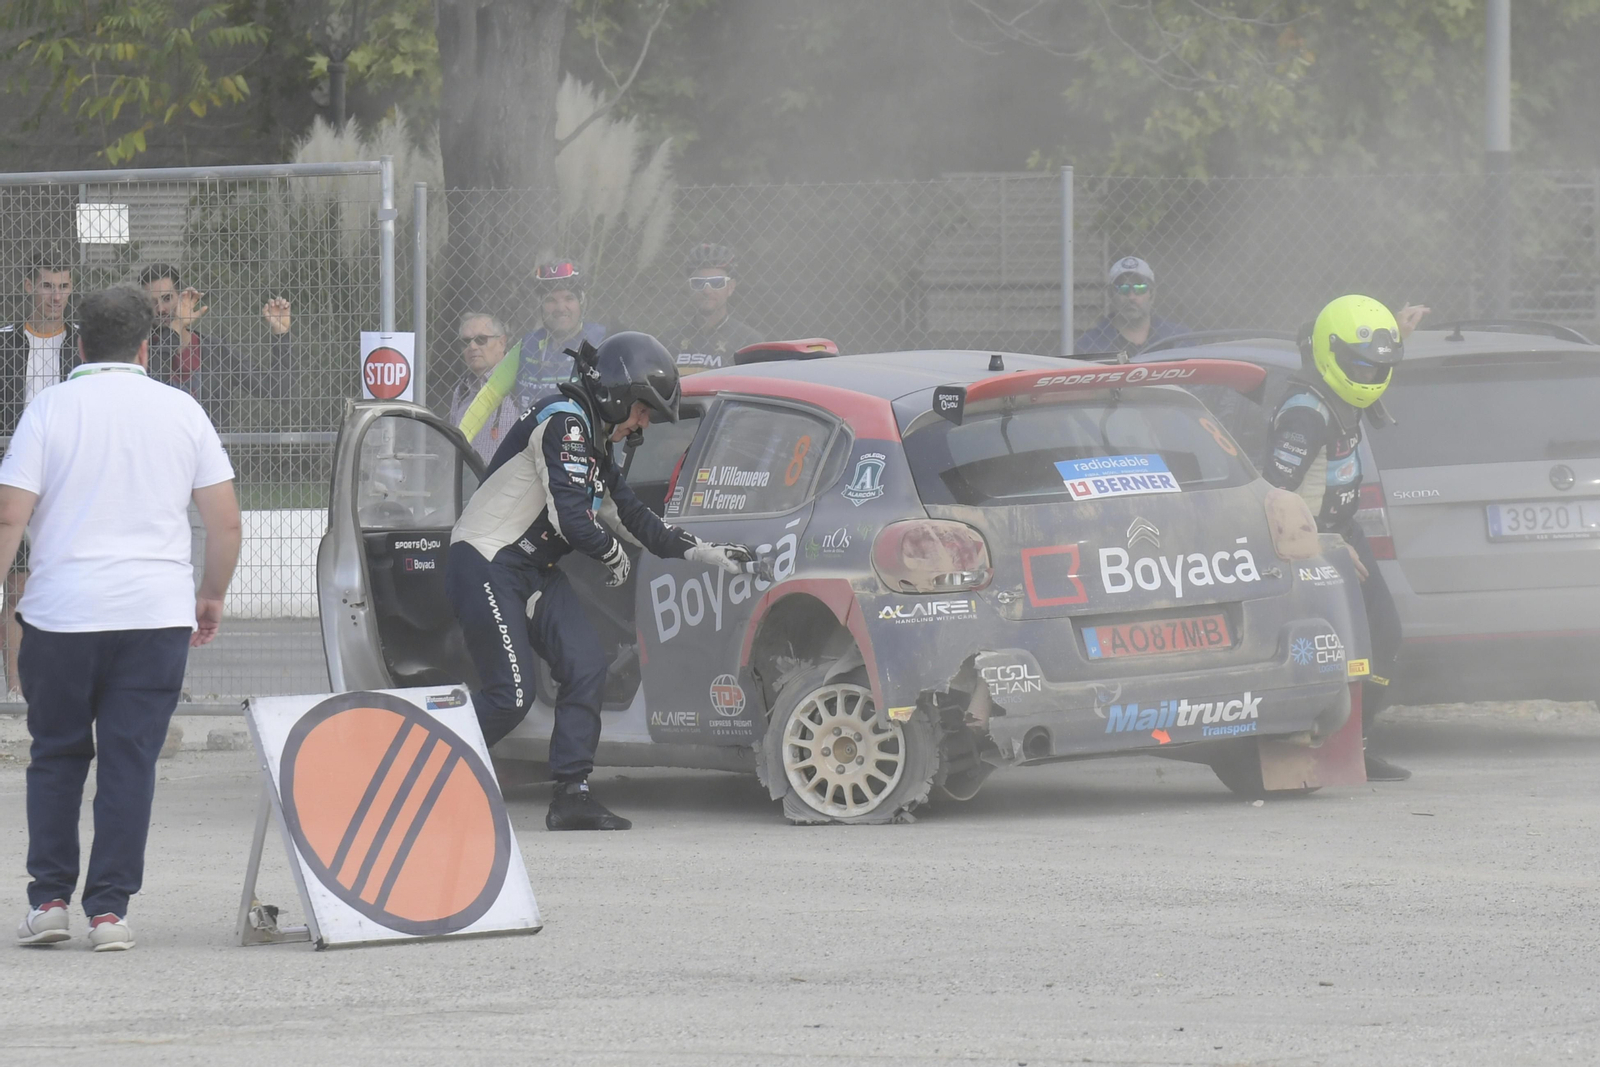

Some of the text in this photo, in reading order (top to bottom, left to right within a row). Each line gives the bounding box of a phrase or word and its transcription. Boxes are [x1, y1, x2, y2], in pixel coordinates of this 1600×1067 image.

[676, 353, 722, 367] BSM
[366, 362, 407, 386] STOP
[1033, 372, 1121, 388] SPORTS
[1199, 417, 1237, 456] 8
[785, 435, 811, 487] 8
[860, 453, 886, 461] COLEGIO
[1073, 457, 1150, 472] radiokable
[707, 466, 770, 487] A.Villanueva
[1092, 475, 1176, 494] BERNER
[703, 489, 747, 510] V.Ferrero
[1507, 507, 1570, 532] 3920
[395, 541, 420, 549] SPORTS
[414, 559, 435, 571] Boyacá
[1099, 537, 1261, 598] Boyacá
[483, 581, 524, 708] www.boyaca.es
[981, 664, 1040, 682] COOL
[1106, 692, 1263, 733] Mailtruck
[709, 720, 753, 728] EXPRESS FREIGHT
[1202, 721, 1257, 737] Transport
